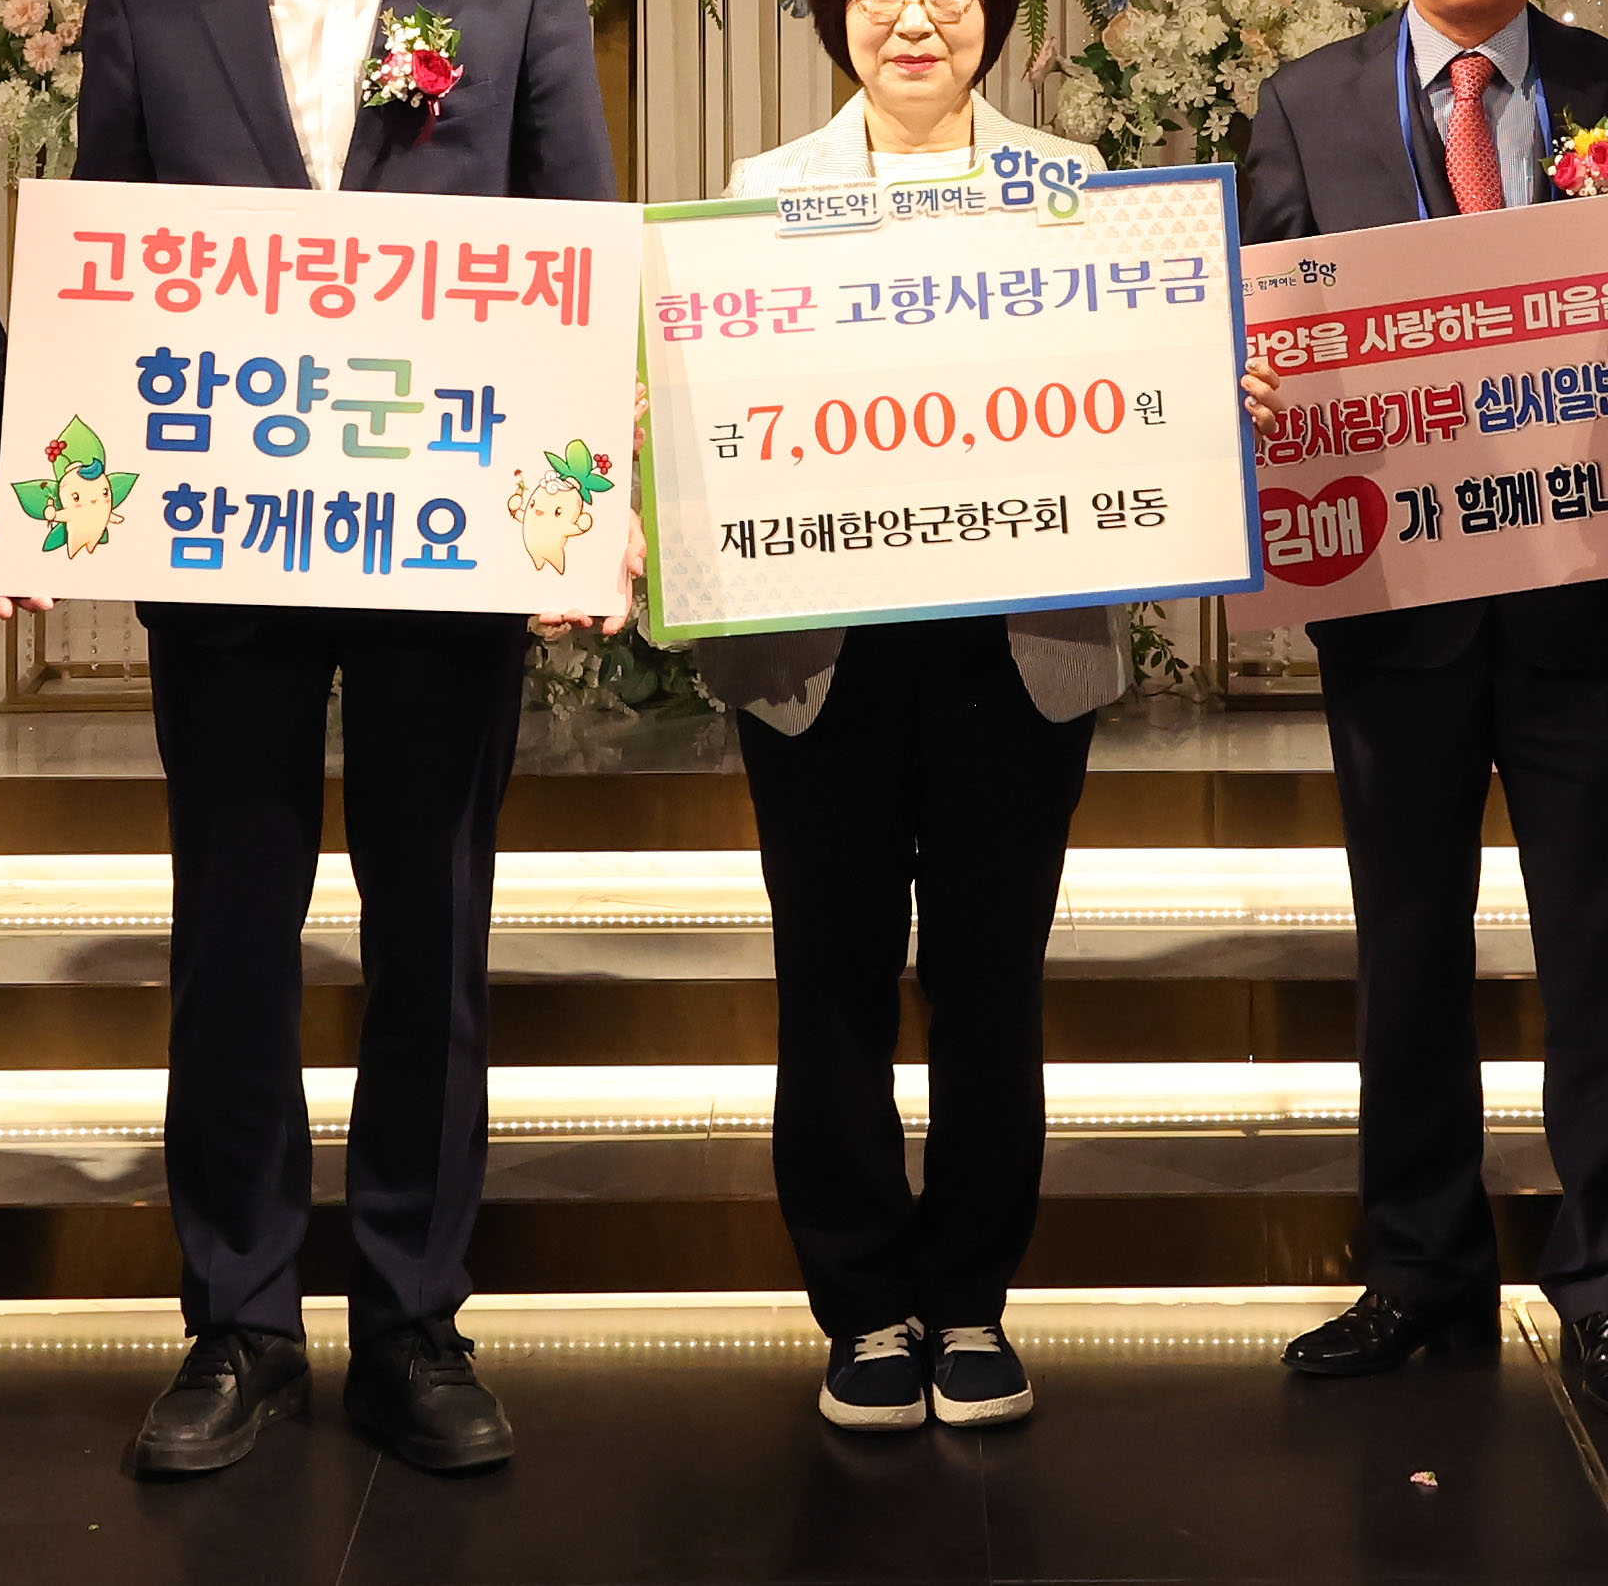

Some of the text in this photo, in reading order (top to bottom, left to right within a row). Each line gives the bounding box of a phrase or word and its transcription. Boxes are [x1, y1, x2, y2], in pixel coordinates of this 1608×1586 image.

[780, 145, 1083, 222] 힘찬도약! 함께여는 함양
[58, 227, 592, 327] 고향사랑기부제
[655, 256, 1210, 343] 함양군 고향사랑기부금
[1298, 258, 1337, 288] 함양
[1359, 306, 1513, 357] 사랑하는
[136, 346, 506, 468] 함양군과
[1255, 384, 1466, 467] 향사랑기부
[162, 482, 477, 575] 함께해요
[720, 487, 1168, 559] 재김해함양군향우회 일동
[1264, 496, 1363, 566] 김해
[1395, 484, 1440, 543] 가
[1454, 469, 1538, 533] 함께
